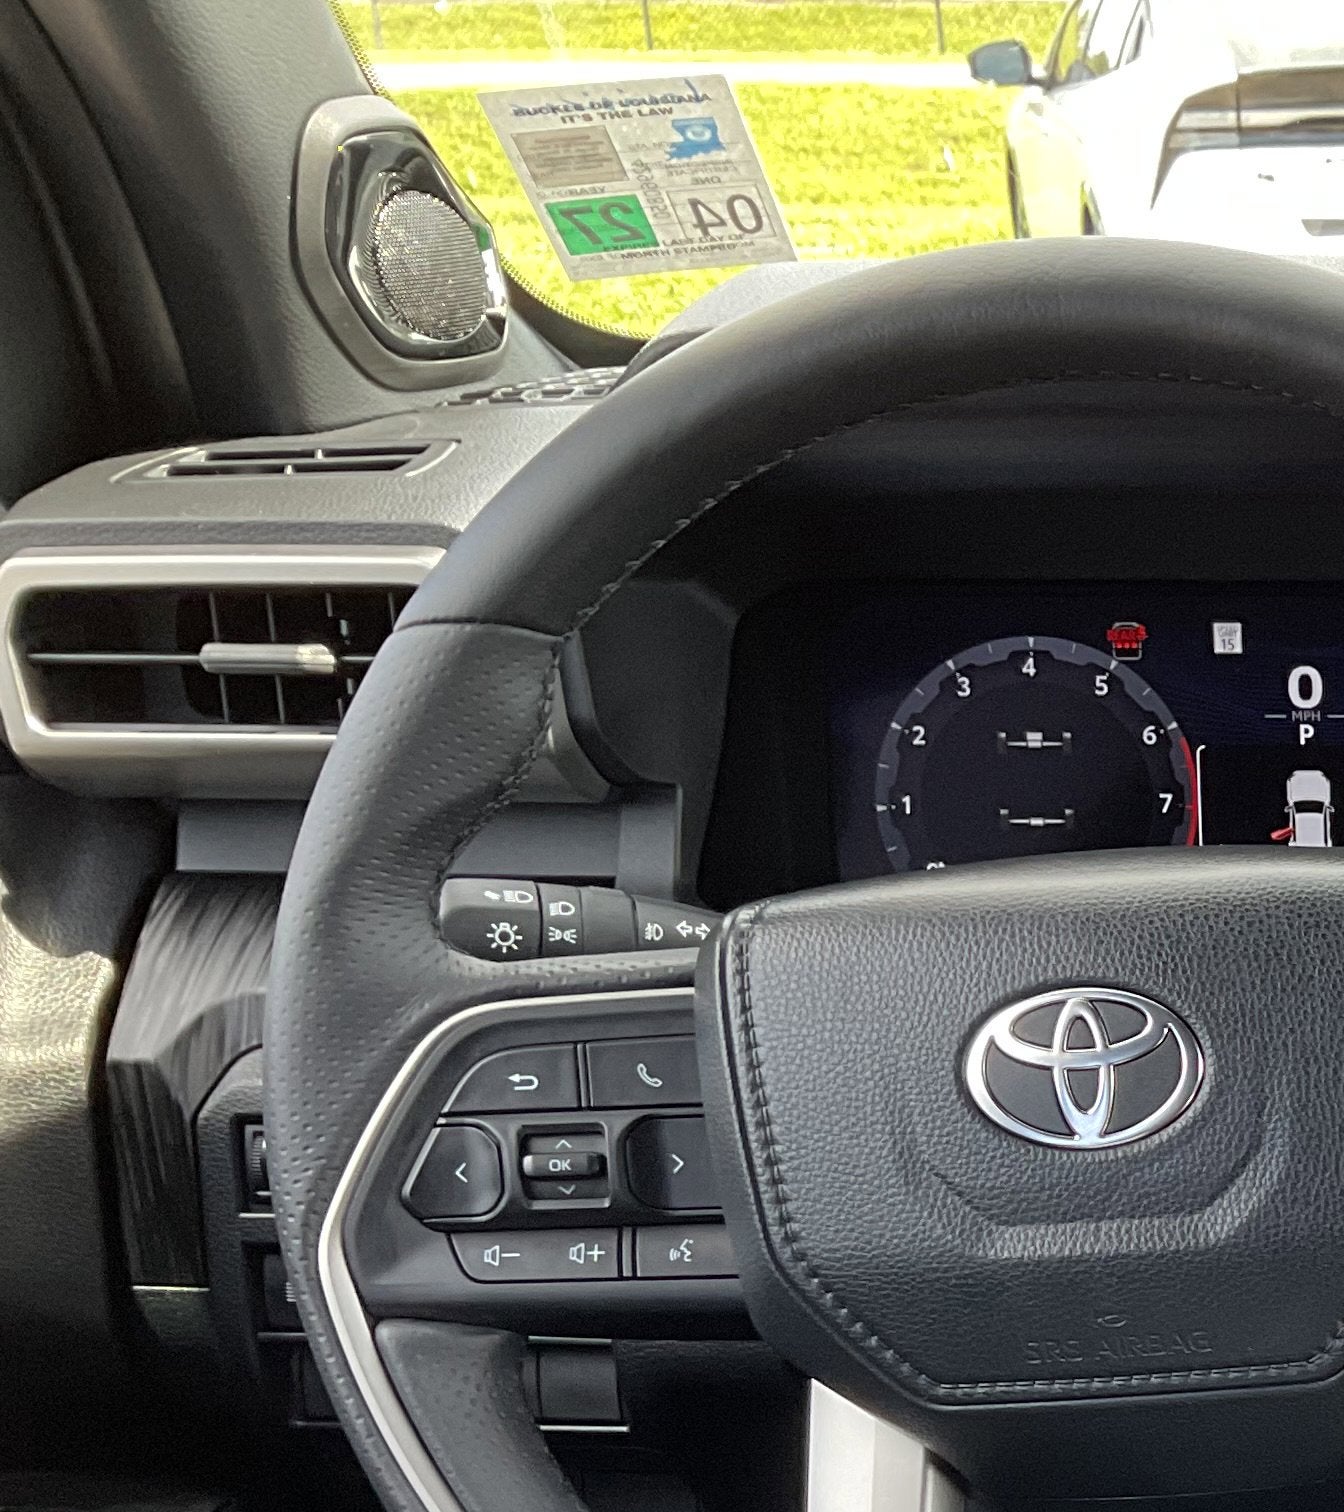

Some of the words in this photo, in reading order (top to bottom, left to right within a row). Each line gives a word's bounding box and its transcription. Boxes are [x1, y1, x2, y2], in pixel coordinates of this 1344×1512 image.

[560, 112, 594, 125] IT'S
[600, 108, 634, 121] THE
[638, 106, 674, 117] LAW
[1221, 638, 1235, 651] 15
[1021, 657, 1037, 677] 4
[956, 676, 971, 697] 3
[1093, 675, 1109, 697] 5
[1287, 665, 1323, 709] 0
[1290, 710, 1322, 722] MPH
[912, 725, 926, 746] 2
[1142, 725, 1157, 745] 6
[1299, 723, 1315, 746] P
[901, 794, 911, 815] 1
[1158, 793, 1173, 814] 7
[548, 1158, 572, 1172] OK
